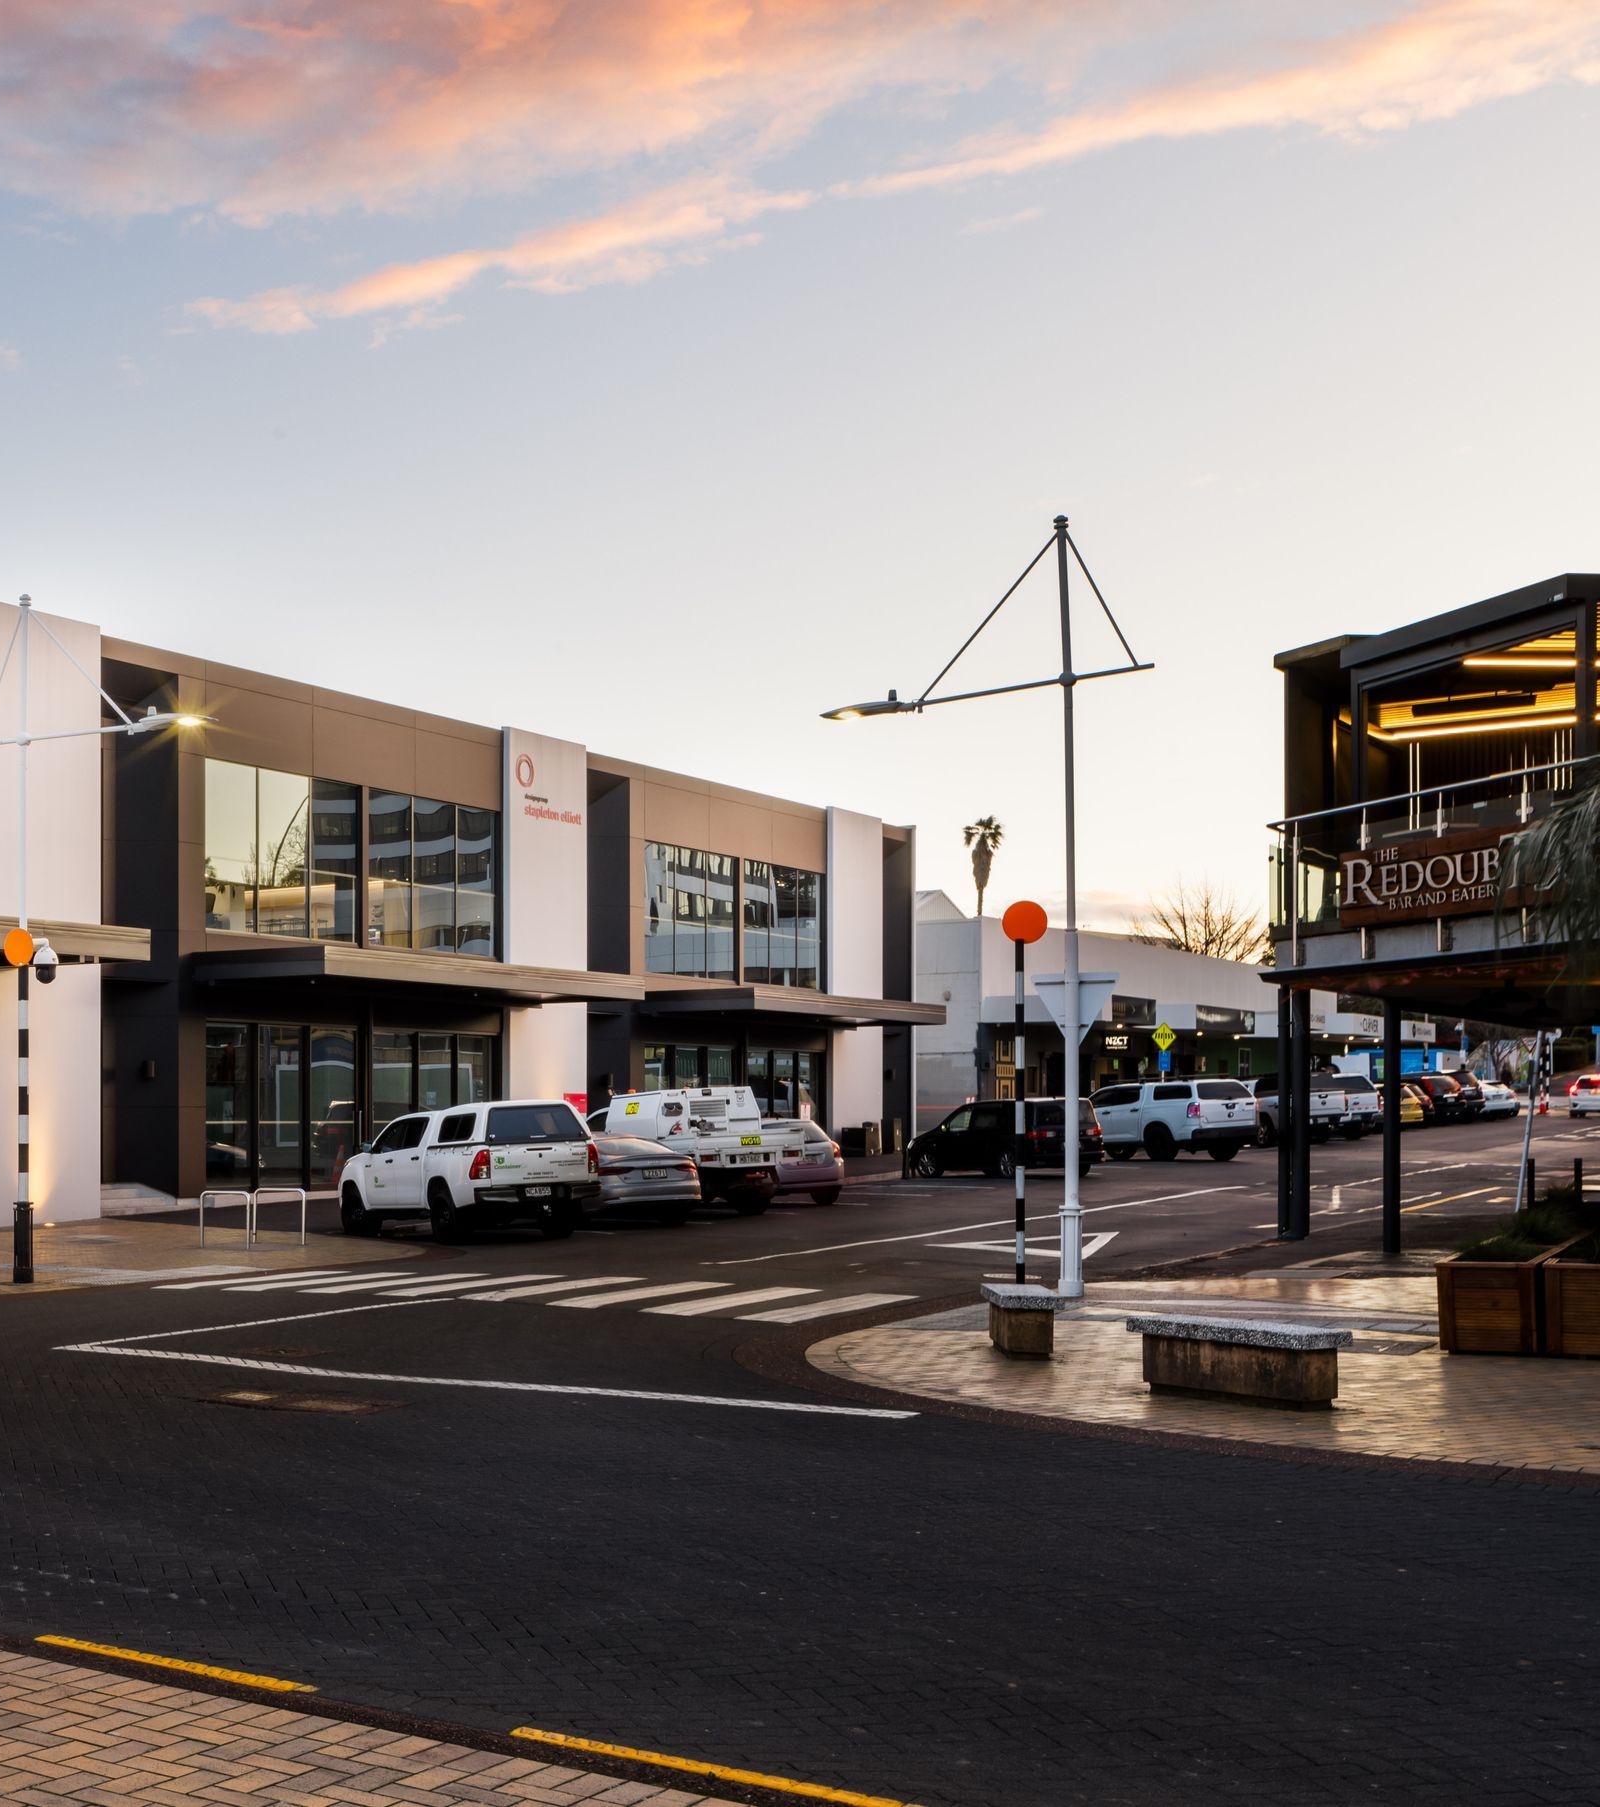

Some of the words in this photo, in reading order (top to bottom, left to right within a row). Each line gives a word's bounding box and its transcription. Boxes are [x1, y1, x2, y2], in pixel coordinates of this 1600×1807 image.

[524, 804, 560, 820] stapleton
[560, 811, 582, 825] elliott
[1373, 847, 1399, 863] THE
[1389, 898, 1413, 911] BAR
[1416, 890, 1447, 906] AND
[1105, 1036, 1129, 1046] NZCT
